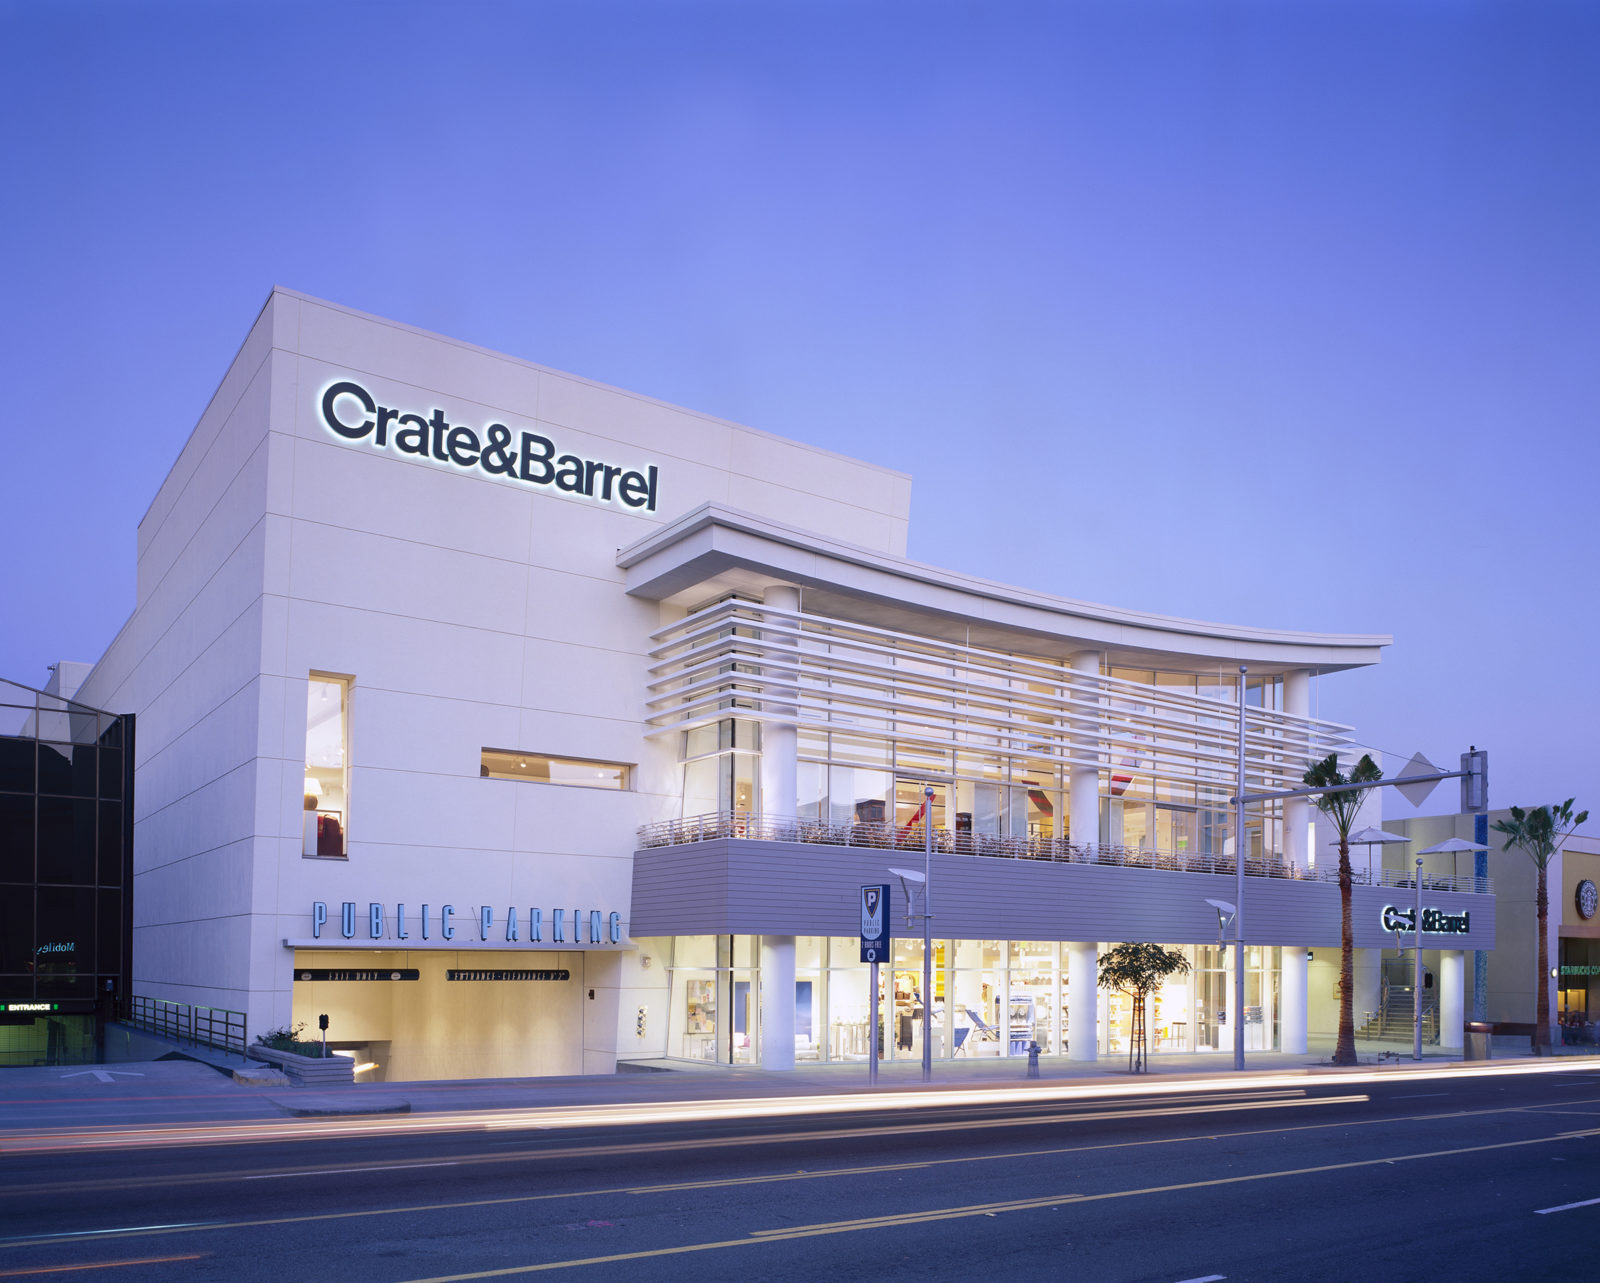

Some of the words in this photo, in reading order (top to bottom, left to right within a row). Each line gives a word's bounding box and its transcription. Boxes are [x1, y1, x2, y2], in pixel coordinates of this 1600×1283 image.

[322, 381, 658, 511] Crate&Barrel
[867, 892, 876, 907] P
[313, 901, 455, 939] PUBLIC
[480, 905, 622, 944] PARKING
[328, 971, 349, 981] EXIT
[8, 1003, 51, 1011] ENTRANCE
